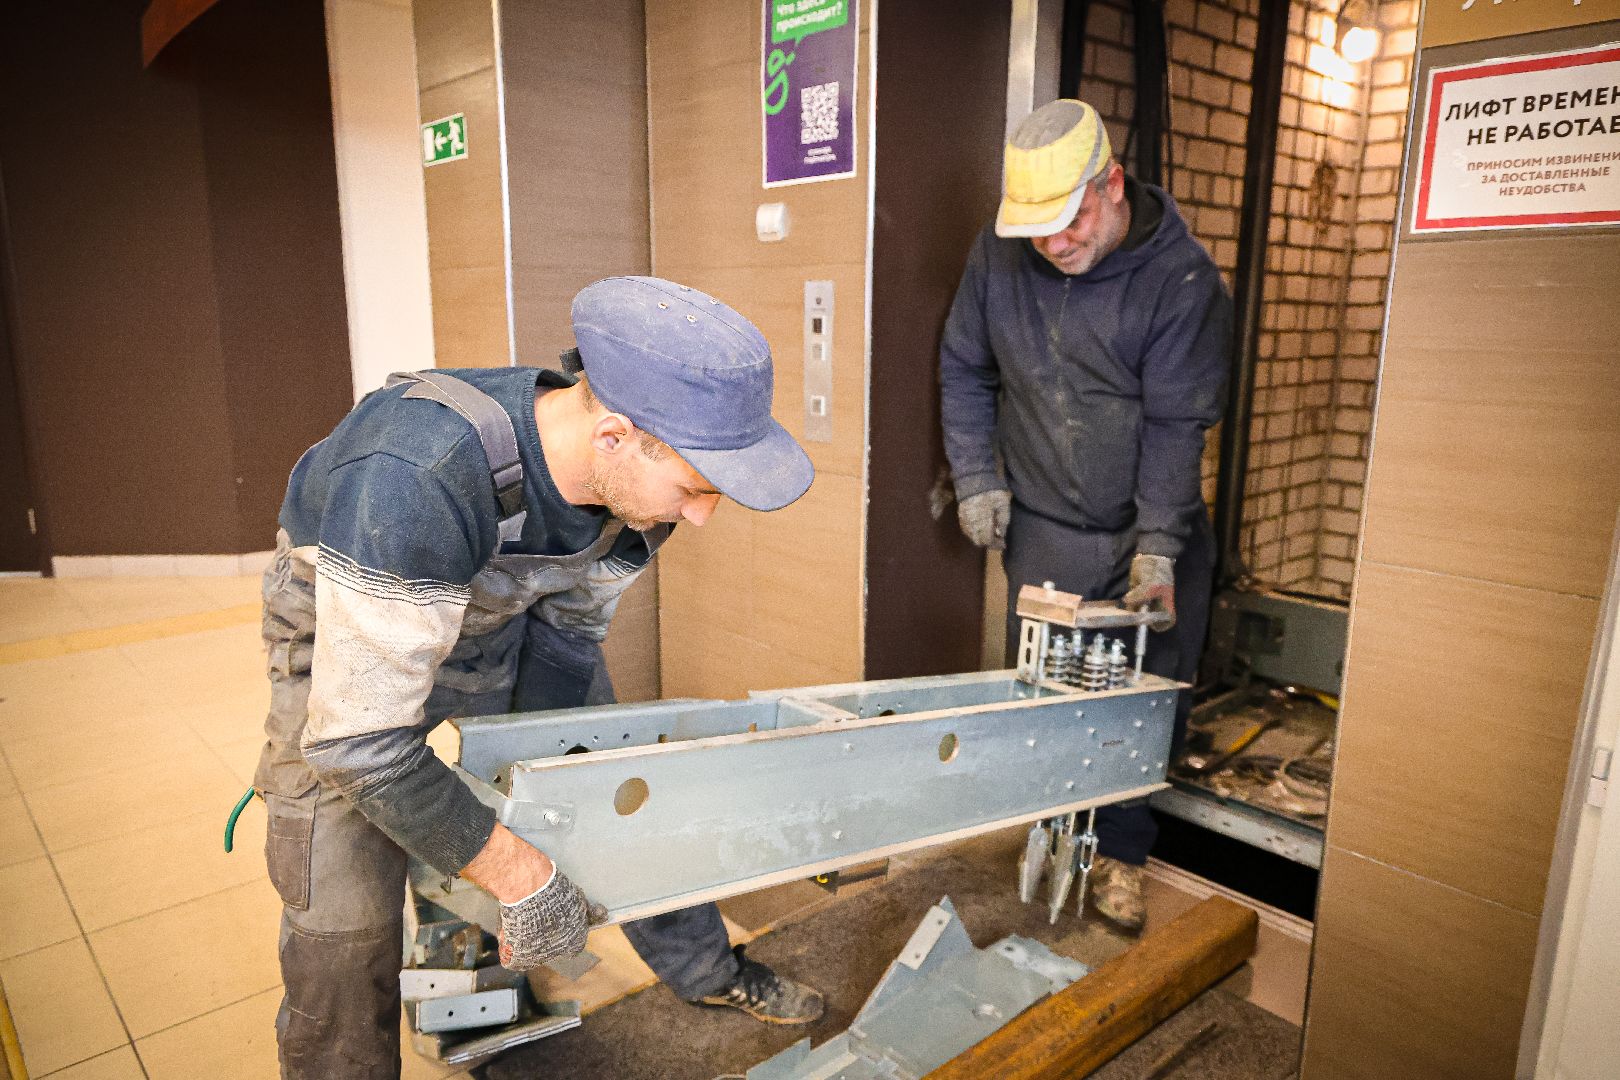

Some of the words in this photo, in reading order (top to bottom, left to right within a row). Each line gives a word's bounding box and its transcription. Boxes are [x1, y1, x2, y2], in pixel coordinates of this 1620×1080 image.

[1446, 97, 1517, 121] ЛИФТ
[1467, 127, 1498, 146] НЕ
[1504, 115, 1620, 143] РАБОТАЕ
[1467, 157, 1543, 171] ПРИНОСИМ
[1545, 151, 1620, 166] ИЗВИНЕНИ
[1481, 174, 1497, 184] ЗА
[1500, 167, 1610, 183] ДОСТАВЛЕННЫЕ
[1500, 184, 1586, 196] НЕУДОБСТВА
